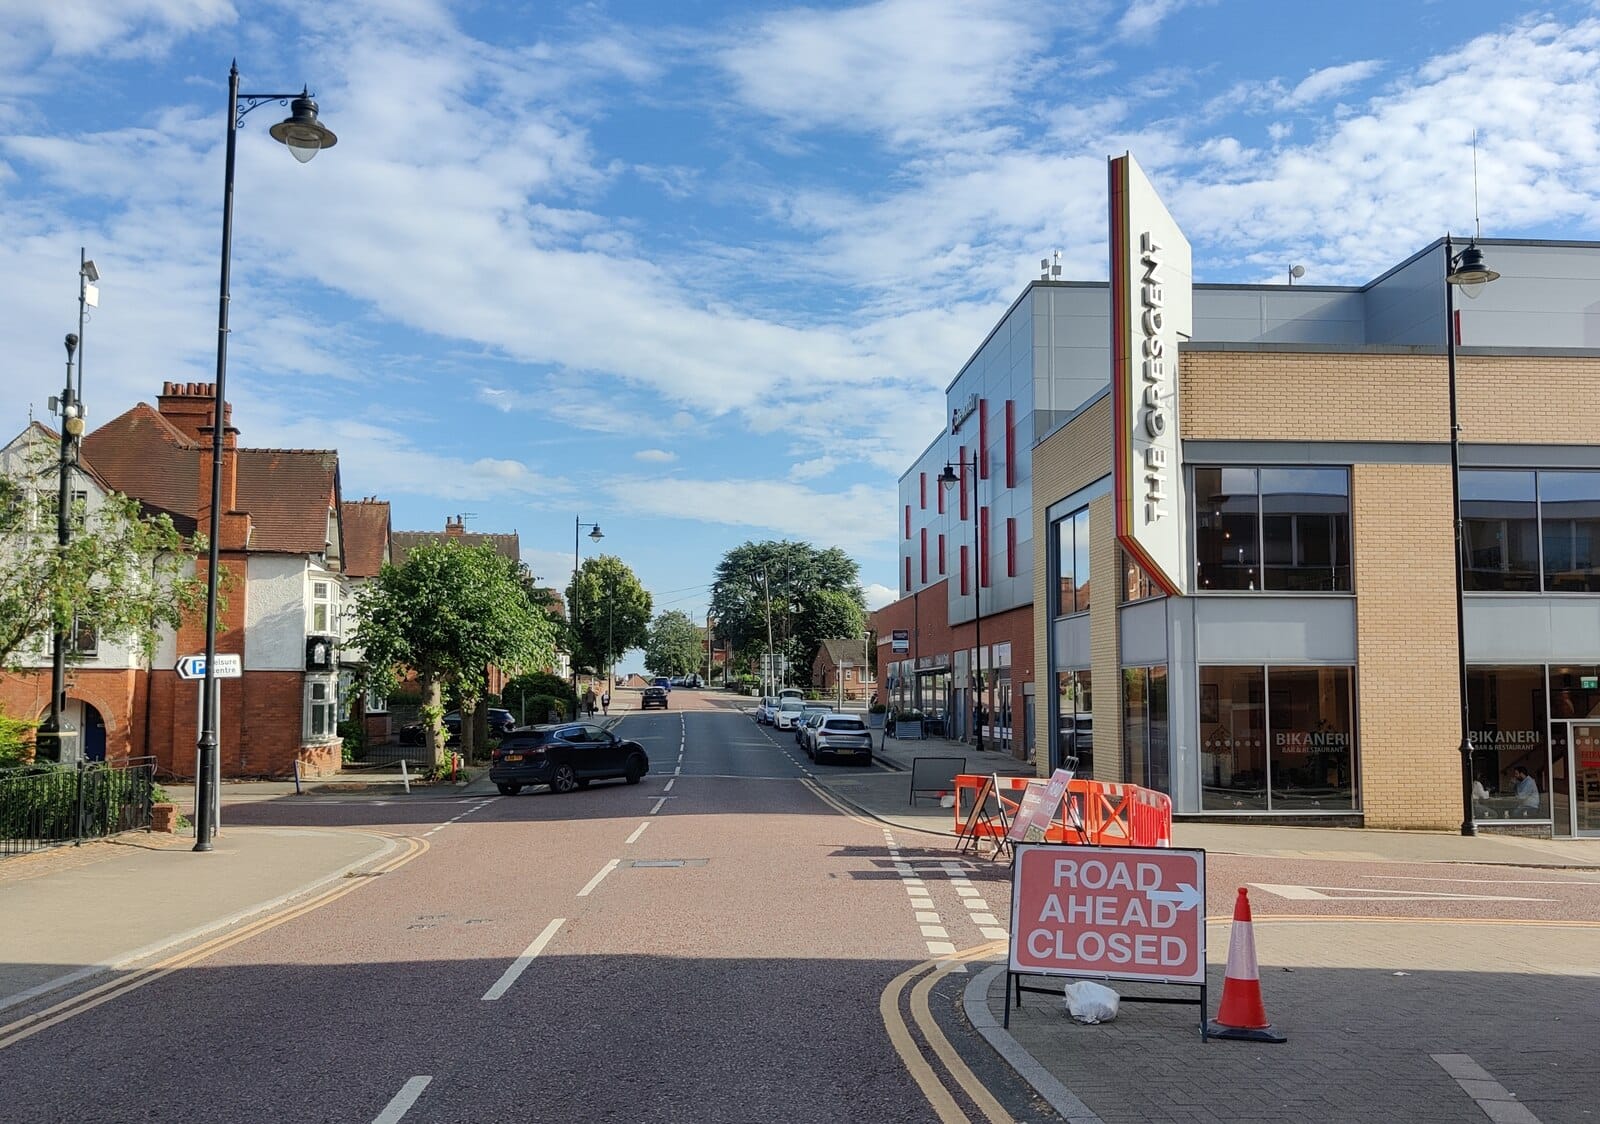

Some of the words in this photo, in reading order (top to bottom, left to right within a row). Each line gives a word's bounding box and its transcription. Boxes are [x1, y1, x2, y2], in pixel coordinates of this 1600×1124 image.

[1140, 231, 1167, 438] CRESCENT
[1144, 446, 1168, 526] THE
[1276, 733, 1349, 746] BIKANERI
[1469, 730, 1539, 743] BIKANERI
[1054, 859, 1163, 892] ROAD
[1038, 894, 1178, 929] AHEAD
[1027, 928, 1188, 967] CLOSED
